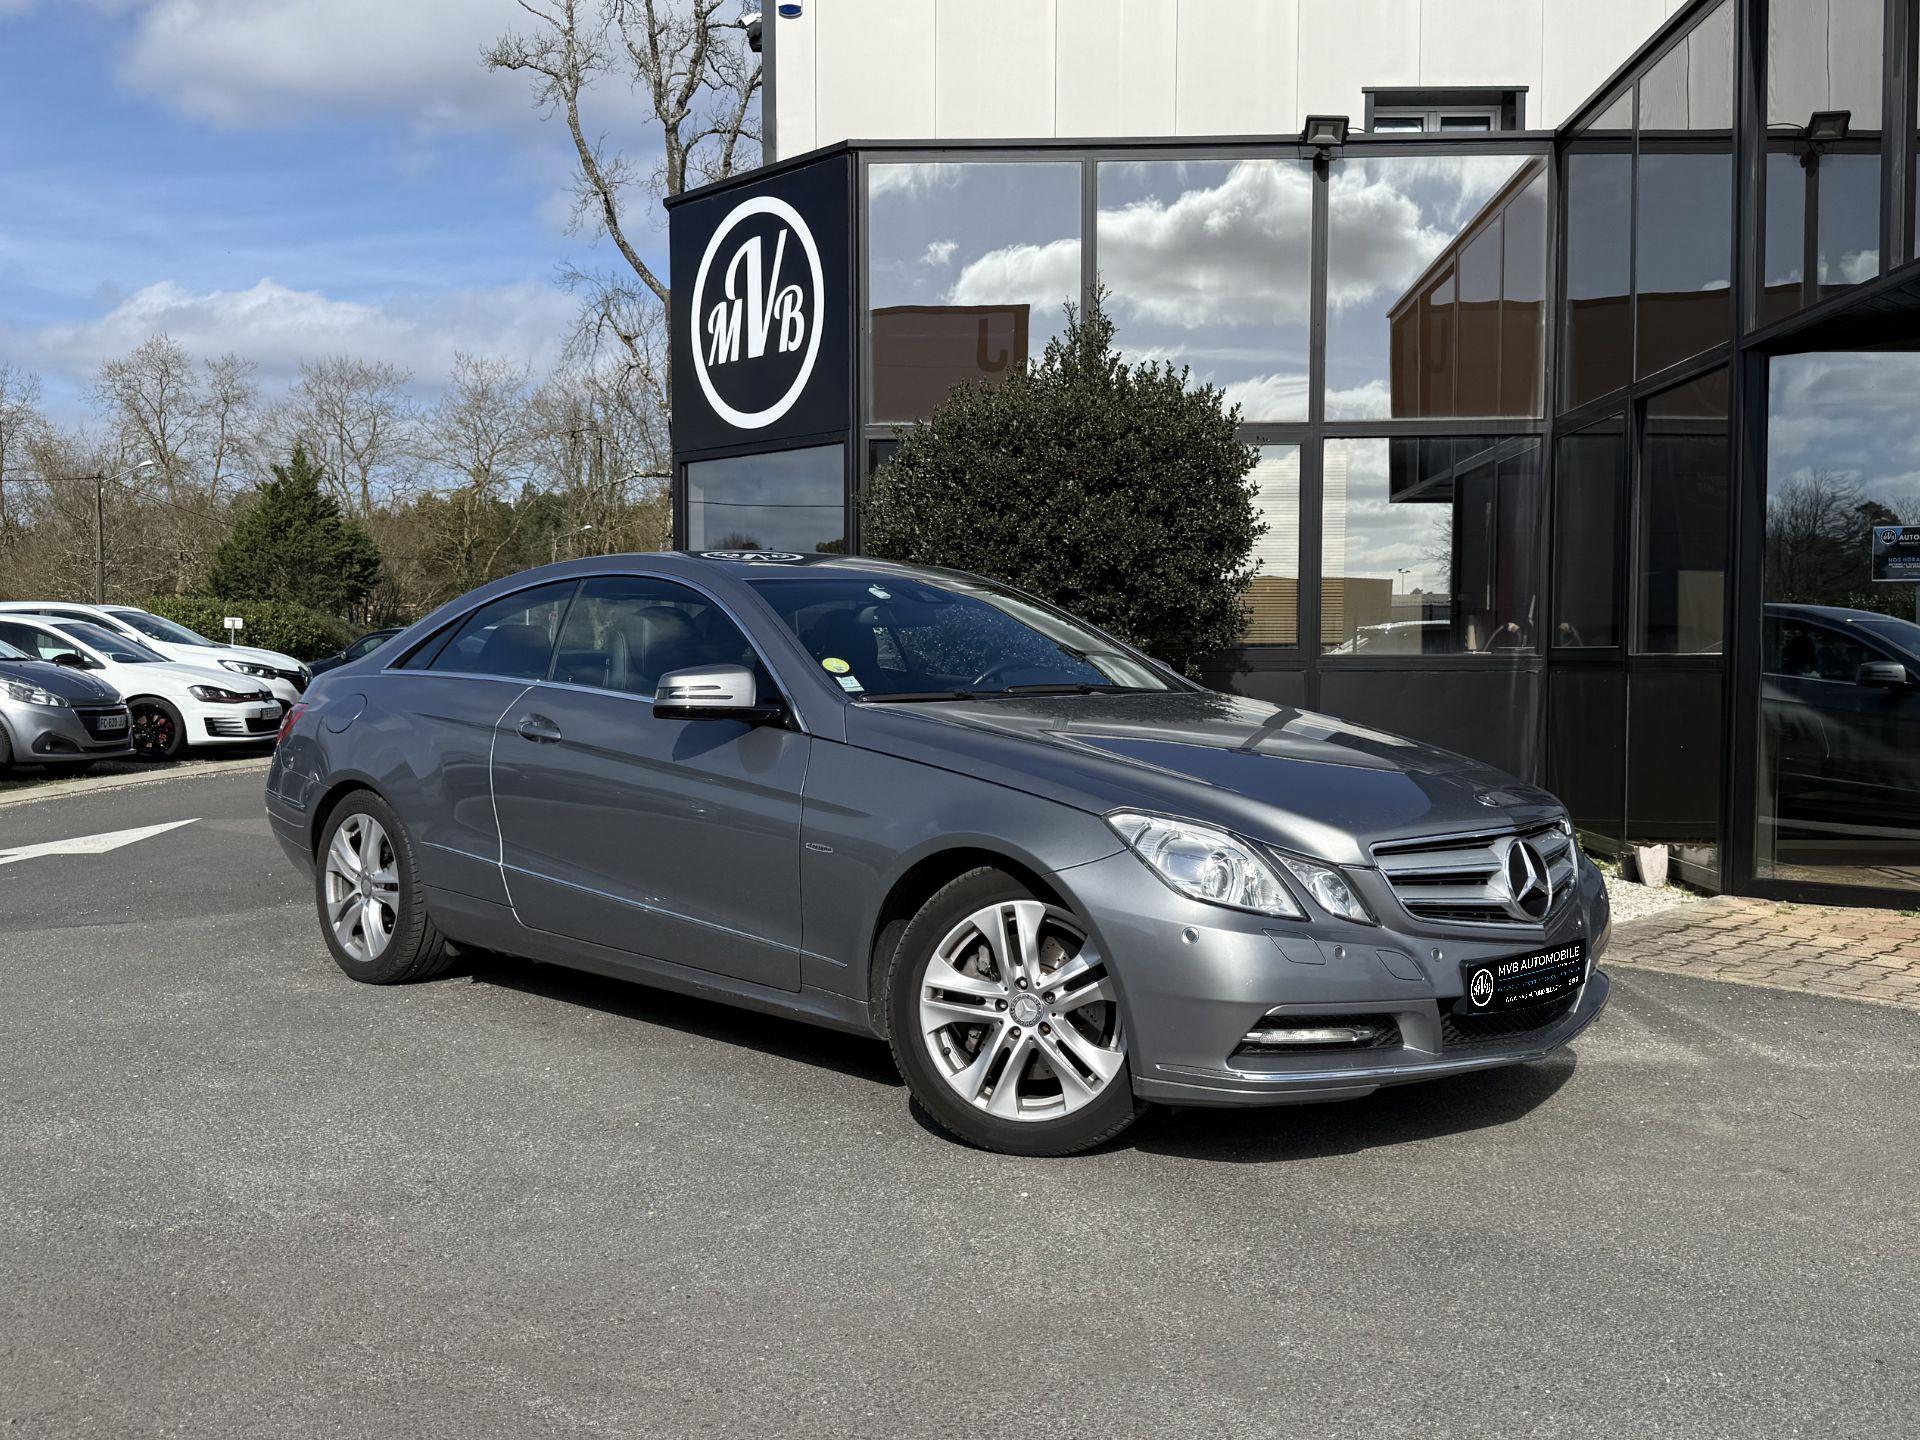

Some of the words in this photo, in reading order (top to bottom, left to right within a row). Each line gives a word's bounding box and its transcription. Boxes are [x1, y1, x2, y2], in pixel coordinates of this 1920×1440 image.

[707, 228, 805, 367] MVB
[1498, 961, 1519, 977] MVB
[1520, 946, 1580, 971] AUTOMOBILE
